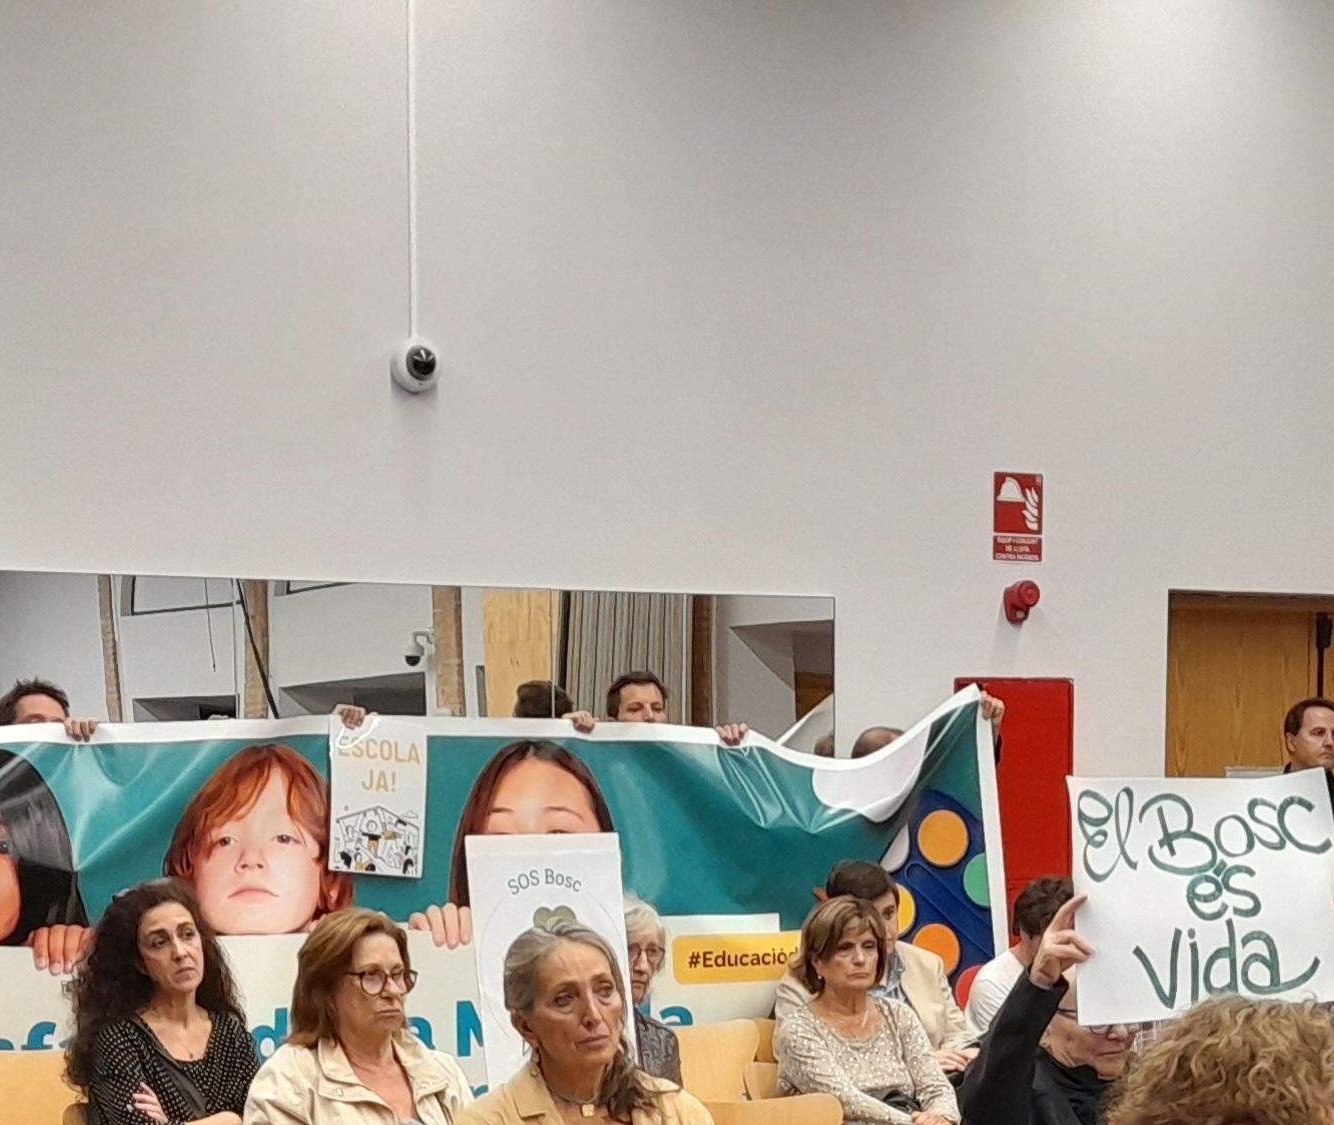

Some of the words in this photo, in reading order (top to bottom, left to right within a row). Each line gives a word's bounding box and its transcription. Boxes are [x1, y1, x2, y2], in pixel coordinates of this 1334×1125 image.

[337, 735, 421, 765] ESCOLA
[361, 769, 397, 793] JA!
[507, 868, 541, 895] SOS
[544, 868, 582, 892] Bosc
